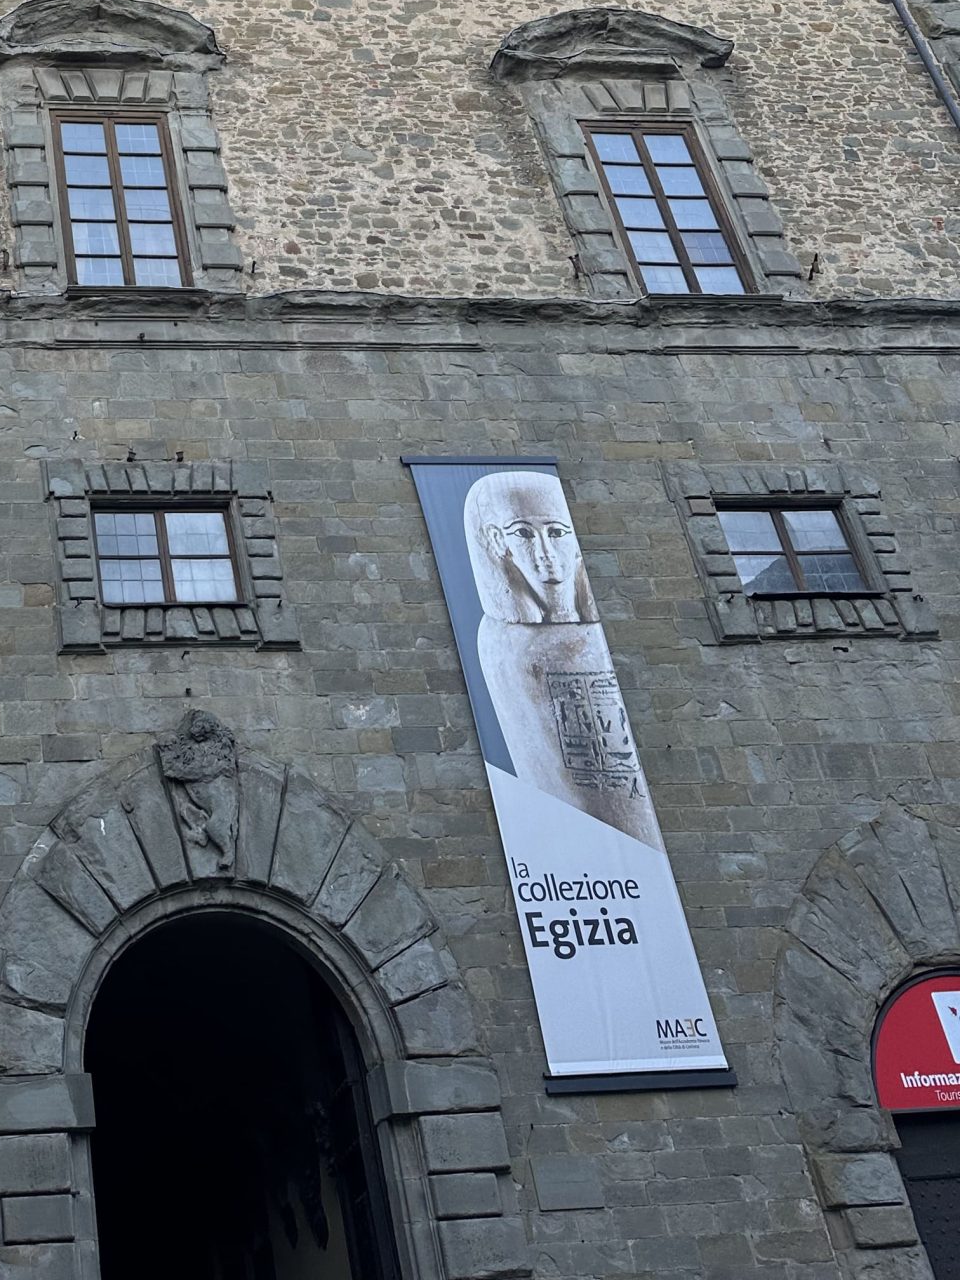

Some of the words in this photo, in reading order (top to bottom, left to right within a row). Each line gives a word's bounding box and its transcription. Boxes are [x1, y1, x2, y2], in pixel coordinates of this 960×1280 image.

[511, 856, 530, 878] la
[517, 872, 641, 902] collezione
[525, 907, 639, 960] Egizia
